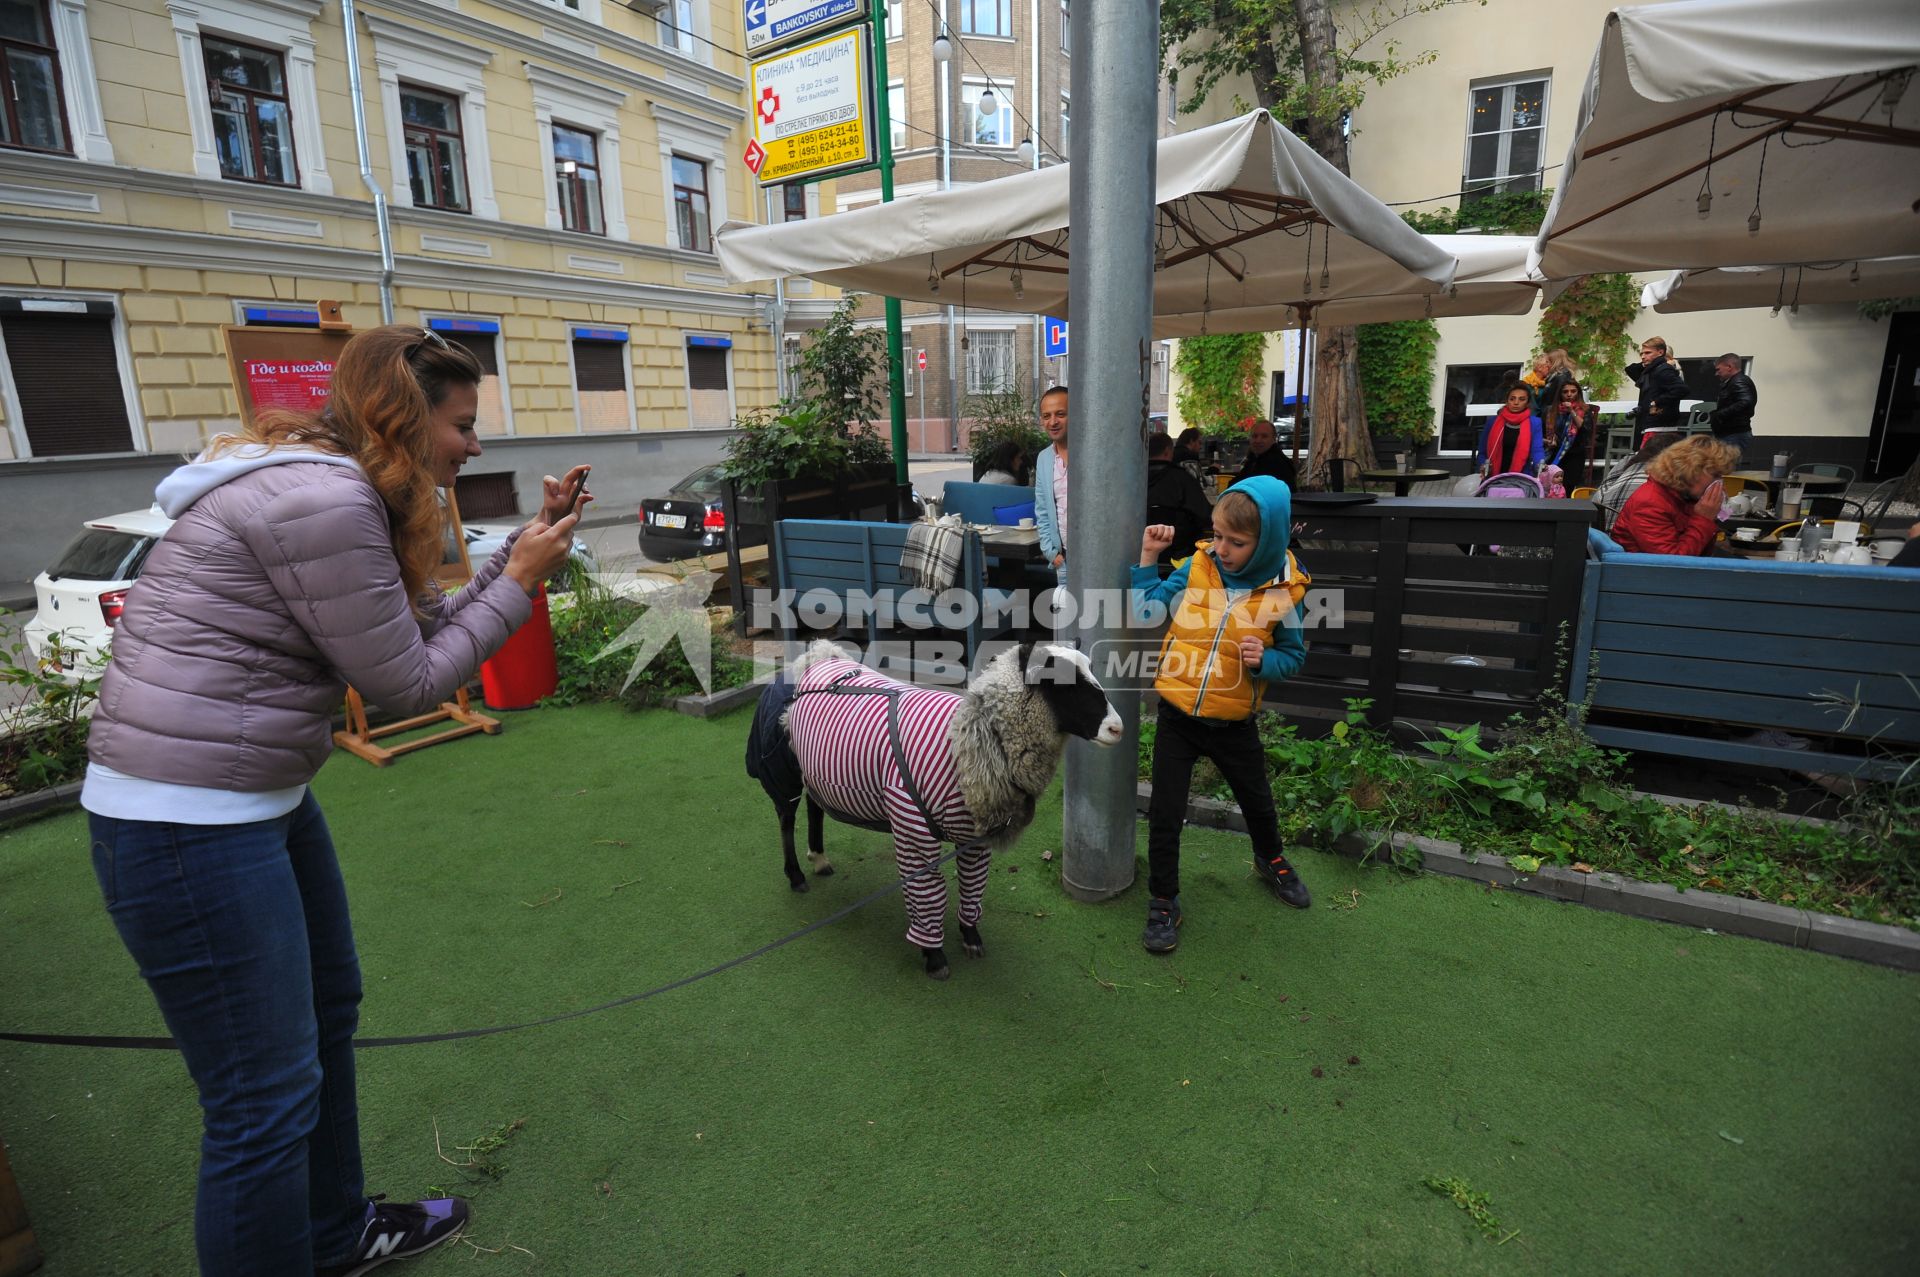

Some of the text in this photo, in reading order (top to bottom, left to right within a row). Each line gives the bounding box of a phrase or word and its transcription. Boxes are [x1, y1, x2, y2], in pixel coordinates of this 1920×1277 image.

[776, 0, 854, 34] BANKOVSKIY side-st.
[756, 60, 794, 82] КЛИНИКА
[815, 79, 822, 87] 21
[797, 87, 838, 103] без выходных
[785, 118, 807, 132] СТРЕЛКЕ
[808, 113, 828, 126] ПРЯМО
[829, 111, 837, 121] ВО
[838, 106, 855, 120] ДВОР
[797, 123, 858, 144] (495) 624-21-41
[799, 135, 859, 157] (495) 624-34-80
[855, 147, 859, 156] 9
[250, 360, 332, 375] Где и когда
